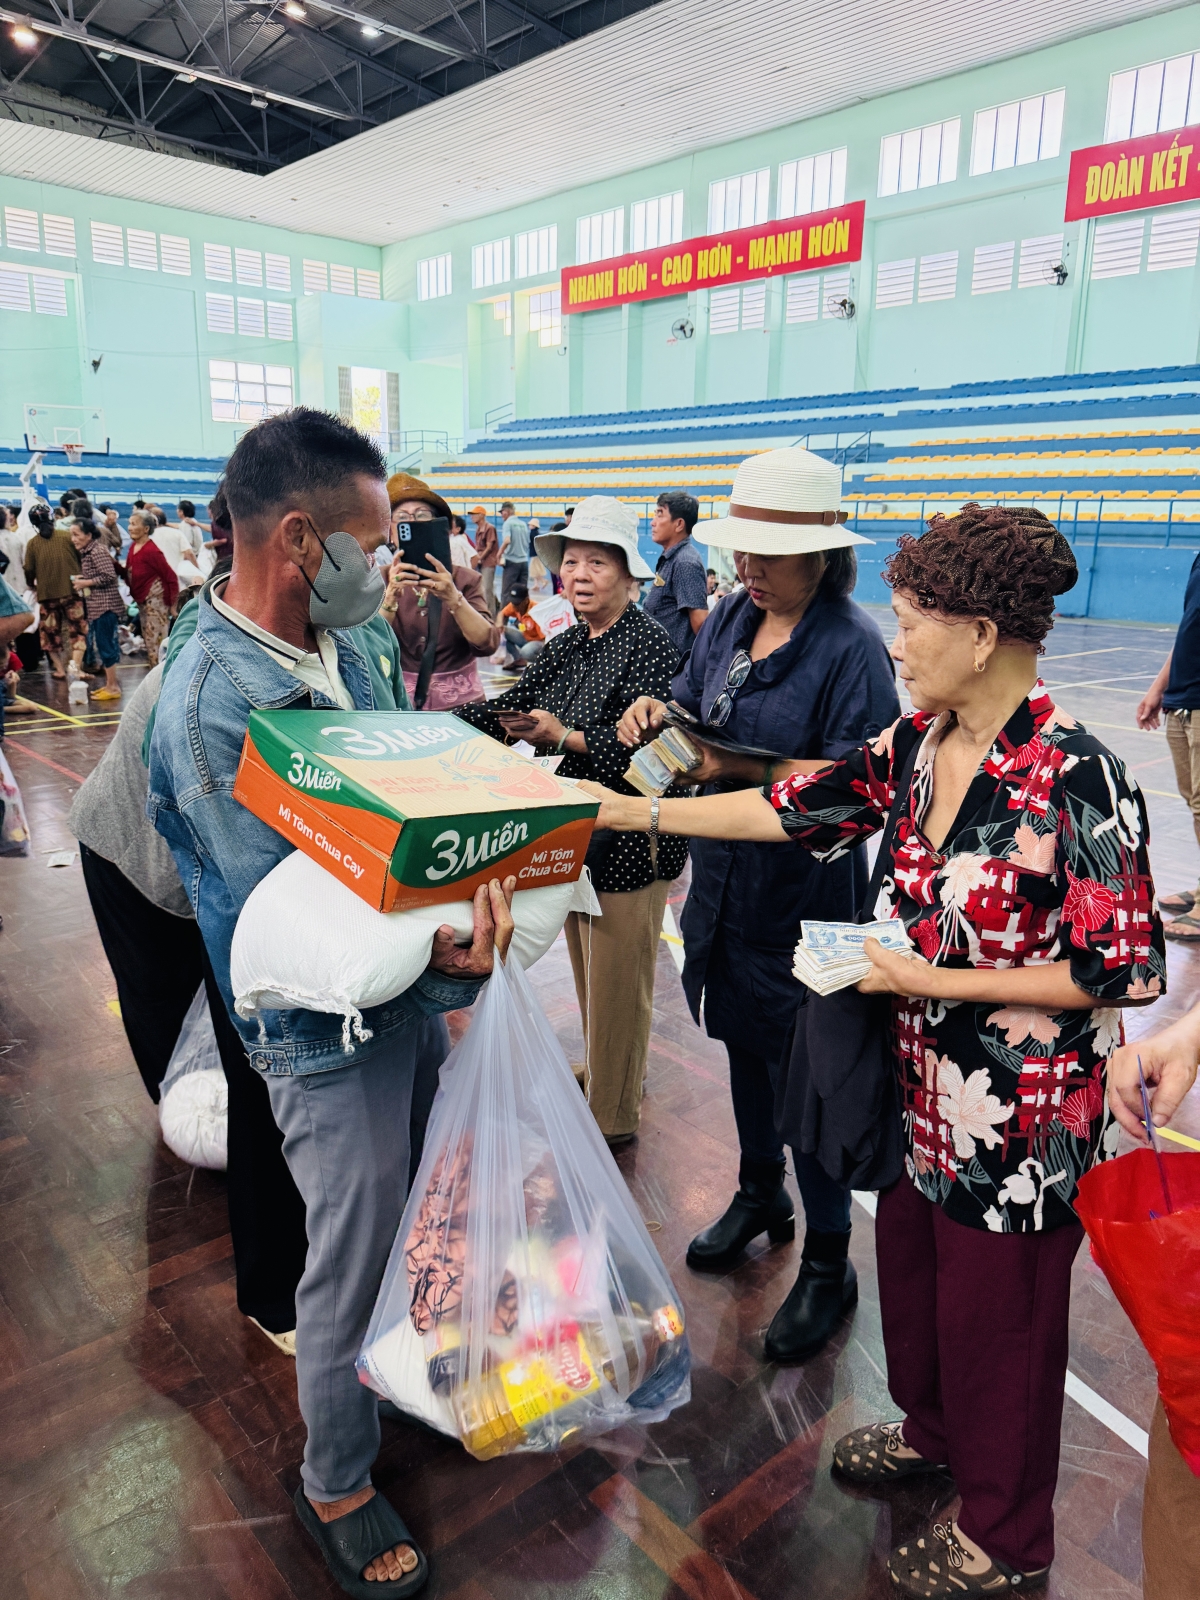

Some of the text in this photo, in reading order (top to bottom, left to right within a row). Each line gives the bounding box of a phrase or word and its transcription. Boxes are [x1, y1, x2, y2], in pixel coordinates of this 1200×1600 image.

[1084, 133, 1194, 205] ĐOÀN KẾT
[568, 272, 614, 305] NHANH
[617, 260, 647, 296] HƠN
[661, 253, 693, 288] CAO
[697, 242, 732, 281] HƠN
[748, 228, 802, 273] MẠNH
[807, 217, 850, 259] HƠN
[278, 803, 365, 879] Mì Tôm Chua Cay
[518, 861, 576, 880] Chua Cay
[531, 848, 574, 865] Mì Tôm
